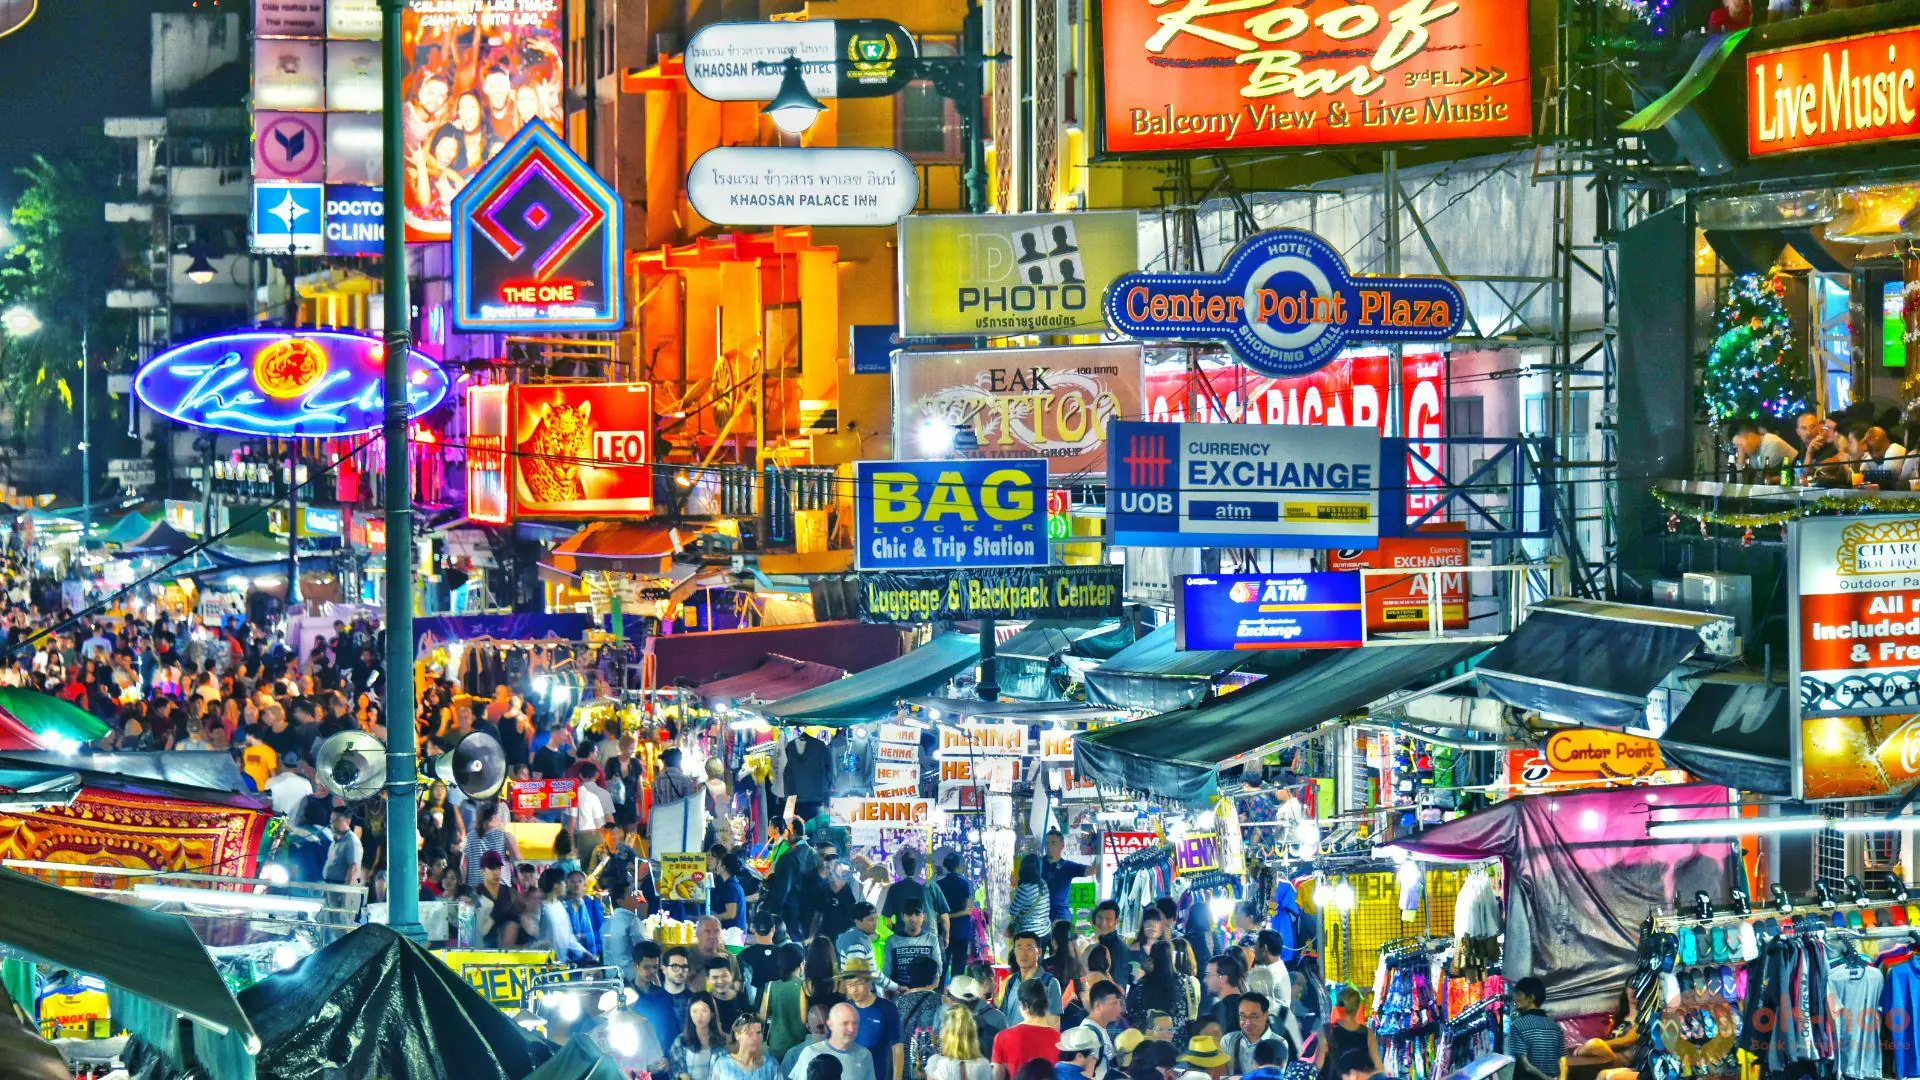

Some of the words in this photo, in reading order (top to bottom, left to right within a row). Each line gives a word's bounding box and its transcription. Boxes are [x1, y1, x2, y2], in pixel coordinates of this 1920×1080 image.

[284, 19, 315, 27] massage
[1145, 0, 1458, 72] Roof
[867, 45, 877, 57] K
[694, 63, 748, 78] KHAOSAN
[799, 62, 832, 75] OTEL
[1235, 49, 1385, 98] Bar
[1756, 62, 1818, 141] Live
[1820, 44, 1917, 134] Music
[1131, 104, 1240, 141] Balcony
[1242, 103, 1317, 133] View
[1326, 101, 1349, 127] &
[1362, 99, 1416, 127] Live
[1423, 94, 1508, 126] Music
[710, 167, 759, 186] โรงแรม
[764, 167, 814, 186] ข้าวสาร
[818, 173, 863, 186] พาเลซ
[327, 200, 384, 216] DOCTO
[729, 194, 795, 207] KHAOSAN
[799, 194, 849, 207] PALACE
[854, 194, 878, 207] INN
[957, 233, 1014, 284] ID
[1268, 242, 1313, 259] HOTEL
[503, 287, 536, 302] THE
[538, 284, 574, 301] ONE
[958, 284, 1087, 313] PHOTO
[1126, 286, 1244, 323] Center
[1257, 287, 1348, 325] Point
[1359, 291, 1452, 327] Plaza
[1237, 323, 1305, 362] SHOPPING
[1308, 323, 1343, 358] MALL
[169, 352, 265, 416] The
[989, 367, 1053, 393] EAK
[597, 435, 642, 464] LEO
[1188, 442, 1270, 456] CURRENCY
[1188, 460, 1371, 489] EXCHANGE
[873, 469, 1035, 523] BAG
[1121, 492, 1173, 514] UOB
[1215, 502, 1251, 519] atm
[874, 524, 1035, 534] LOCKER
[872, 537, 907, 559] Chic
[913, 537, 927, 558] &
[932, 536, 966, 561] Trip
[973, 535, 1034, 558] Station
[1430, 546, 1462, 554] Currency
[1394, 555, 1462, 568] EXCHANGE
[1262, 584, 1307, 602] ATM
[1409, 572, 1463, 595] AM
[1840, 578, 1896, 590] Outdoor
[869, 583, 940, 620] Luggage
[948, 579, 960, 611] &
[968, 577, 1049, 616] Backpack
[1057, 576, 1115, 607] Center
[1869, 596, 1904, 615] All
[1812, 617, 1920, 641] included
[1850, 643, 1871, 663] &
[1842, 682, 1904, 697] Entering
[880, 747, 912, 758] HENNA
[1553, 737, 1610, 763] Center
[1616, 741, 1655, 759] Point
[876, 785, 916, 798] HENNA
[851, 802, 928, 822] HENNA
[1105, 836, 1160, 847] SIAM
[896, 947, 931, 955] BELOVED
